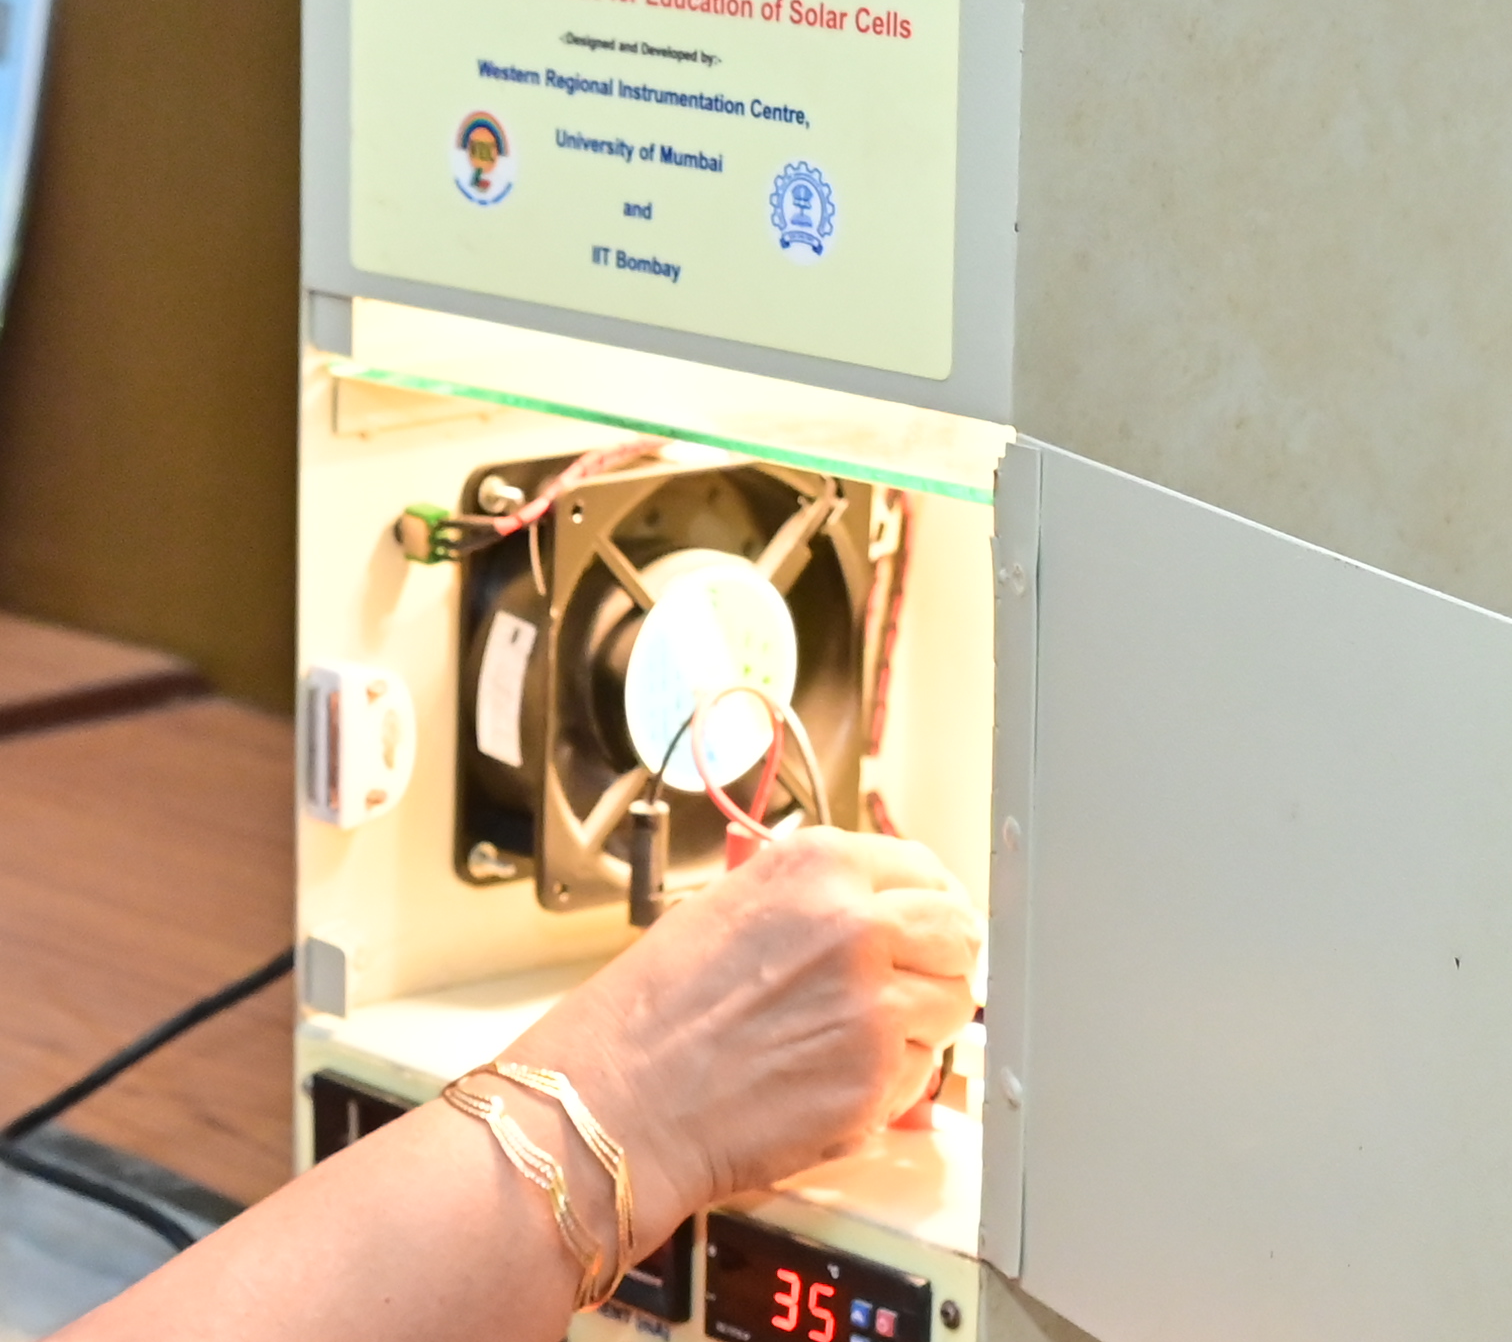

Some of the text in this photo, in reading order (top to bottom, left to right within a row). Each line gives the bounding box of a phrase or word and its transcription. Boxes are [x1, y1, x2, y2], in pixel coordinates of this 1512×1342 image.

[855, 7, 912, 40] Cells
[619, 41, 638, 54] and
[641, 41, 698, 64] Developed
[477, 58, 810, 129] Western Regional Instrumentation Centre,
[555, 128, 723, 173] University of Mumbai
[623, 201, 653, 220] and
[592, 245, 681, 283] IIT Bombay
